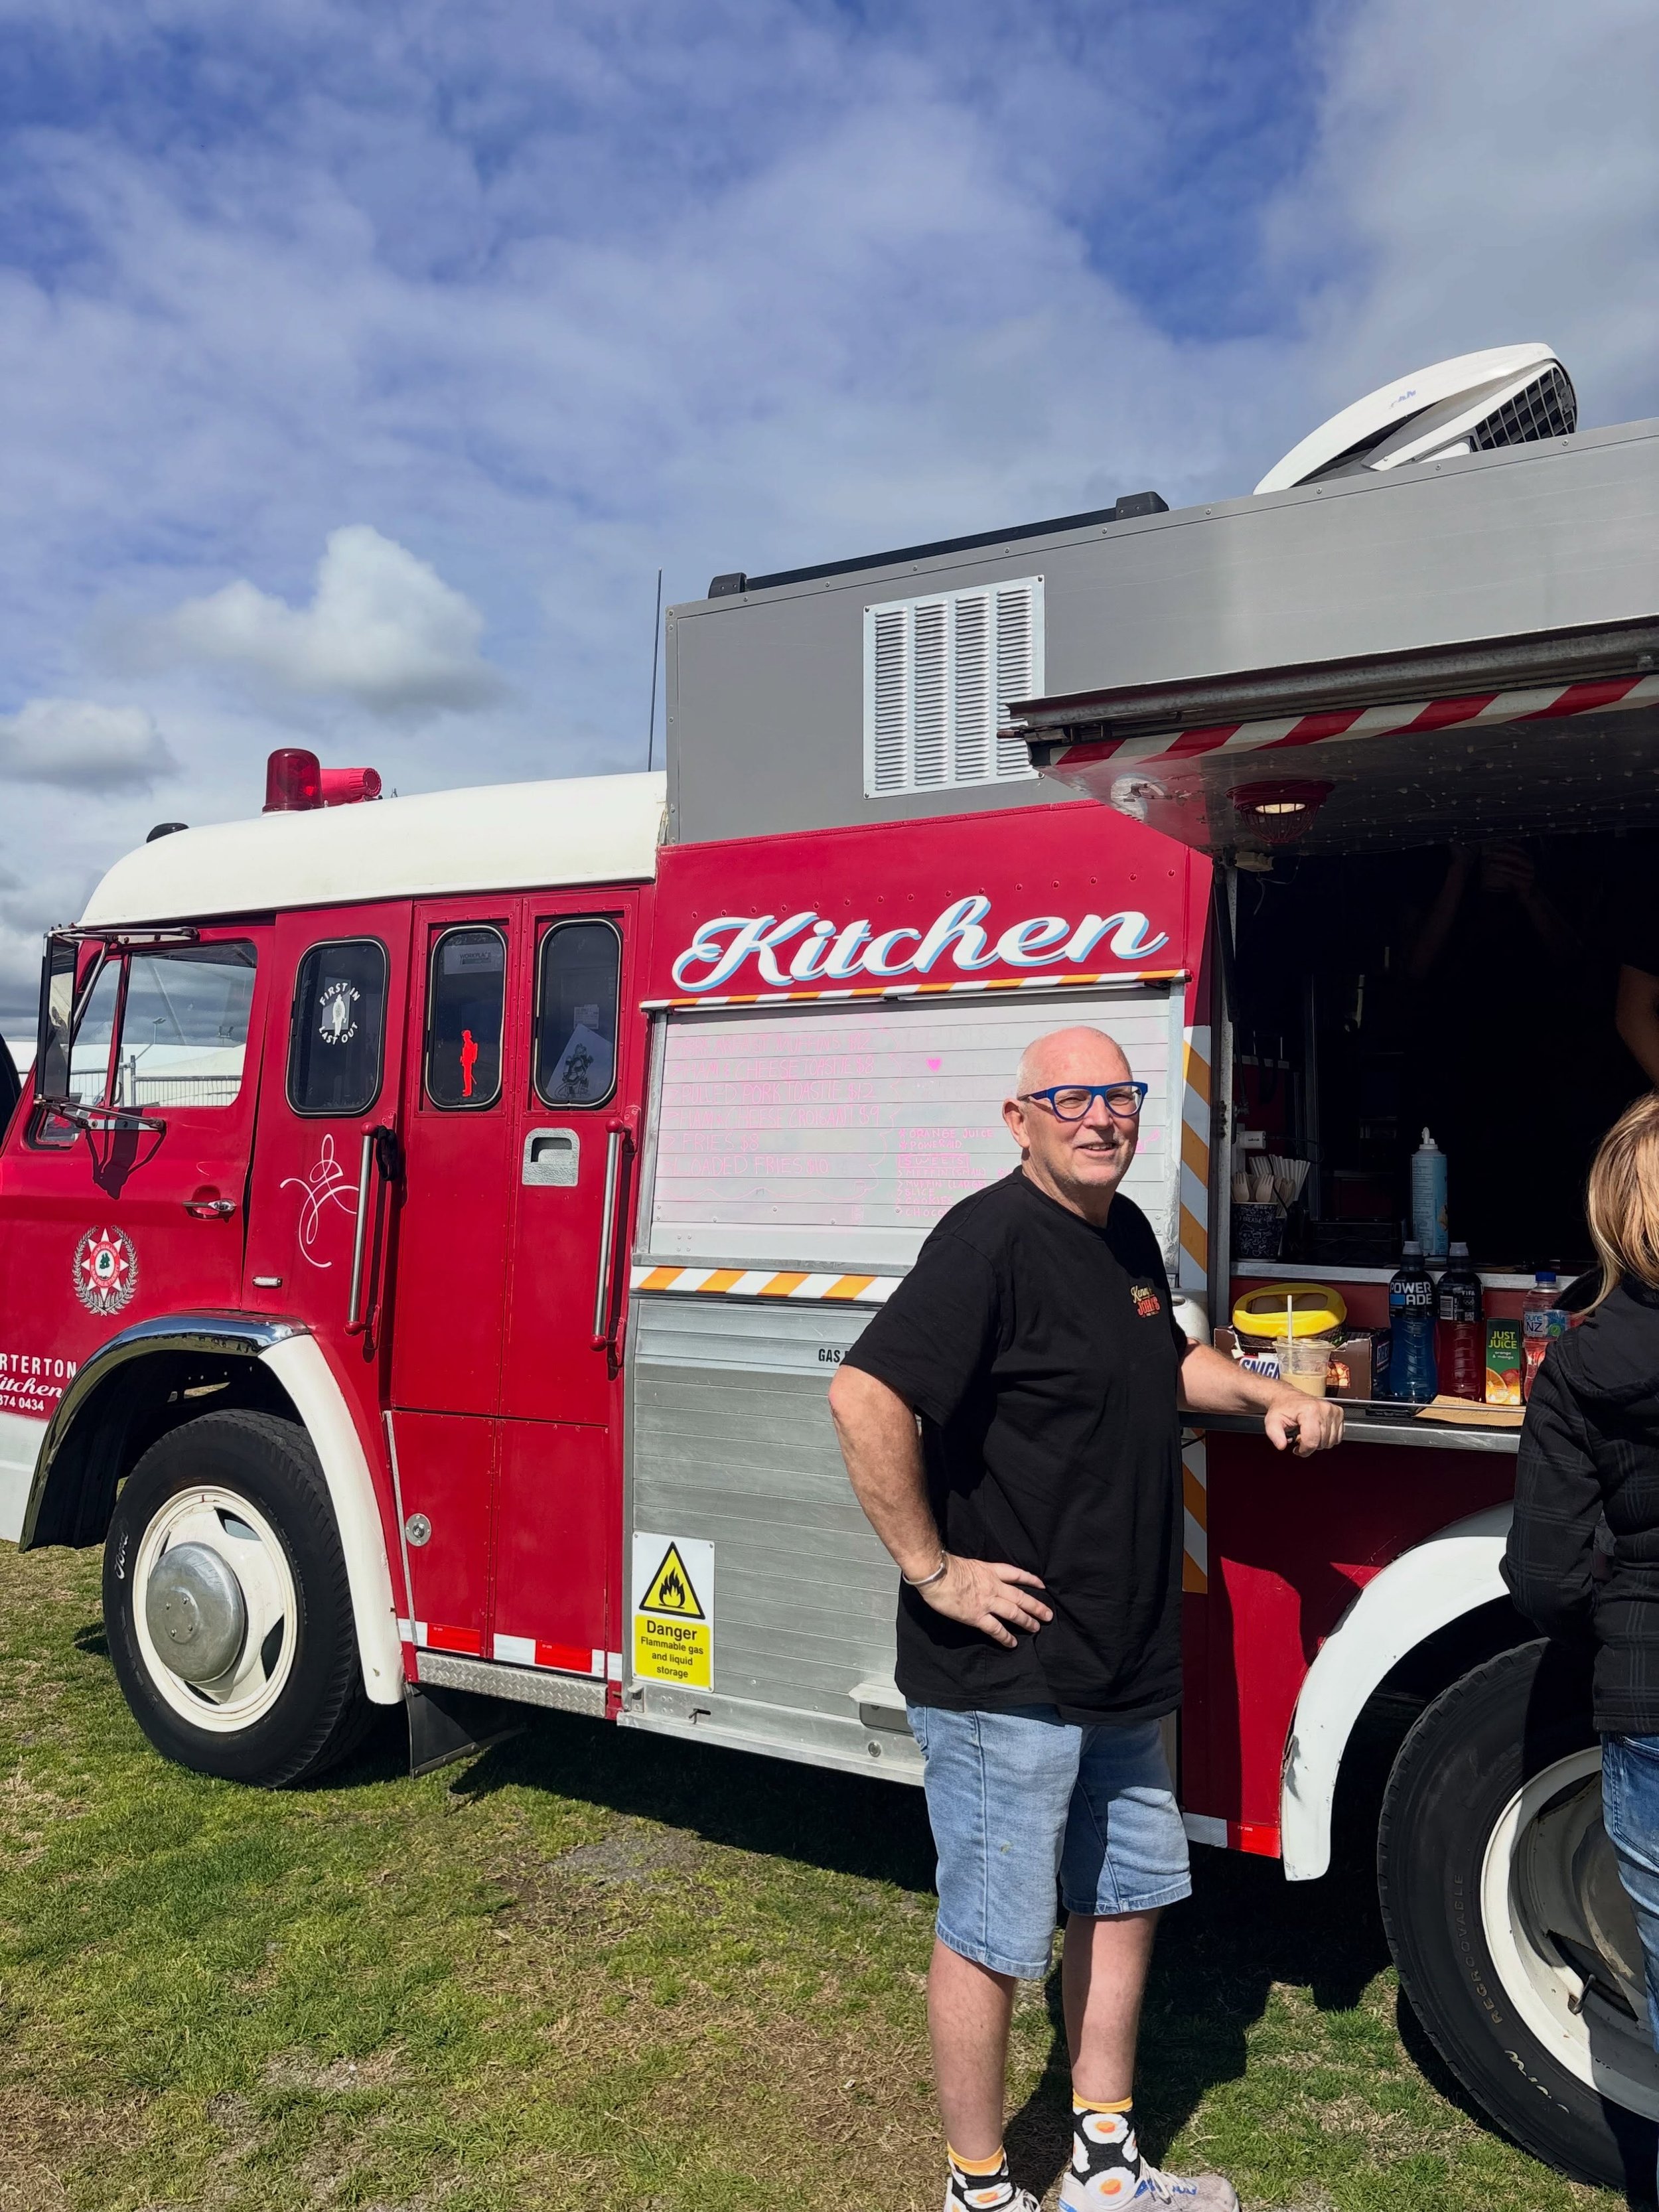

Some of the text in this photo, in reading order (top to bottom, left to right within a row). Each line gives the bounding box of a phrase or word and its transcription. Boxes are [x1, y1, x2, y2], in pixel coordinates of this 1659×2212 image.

[672, 894, 1170, 992] Kitchen
[319, 982, 360, 1006] FIRST IN
[319, 1021, 358, 1045] LAST OUT
[682, 1061, 719, 1080] HAM
[735, 1059, 798, 1080] CHEESE
[801, 1057, 853, 1077] TOASTIE
[682, 1084, 737, 1106] PULLED
[741, 1082, 781, 1105] PORK
[785, 1080, 843, 1102] TOASTIE
[679, 1107, 715, 1130] HAM
[723, 1107, 784, 1130] CHEESE
[909, 1128, 994, 1139] ORANGE JUICE
[682, 1133, 760, 1153] FRIES $8
[672, 1155, 748, 1176] LOADED
[754, 1157, 803, 1175] FRIES
[904, 1155, 964, 1166] SWEETS
[905, 1207, 948, 1217] CHOCO
[1390, 1282, 1432, 1294] POWER
[1406, 1293, 1433, 1305] ADE
[1491, 1330, 1516, 1340] JUST
[1526, 1322, 1543, 1333] NZ
[1488, 1339, 1518, 1349] JUICE
[818, 1348, 841, 1363] GAS
[19, 1396, 44, 1412] 0434
[646, 1619, 697, 1642] Danger
[640, 1636, 704, 1655] Flammable gas
[652, 1651, 693, 1666] and liquid
[656, 1666, 689, 1679] storage
[1453, 1874, 1504, 2025] REGROOVABLE
